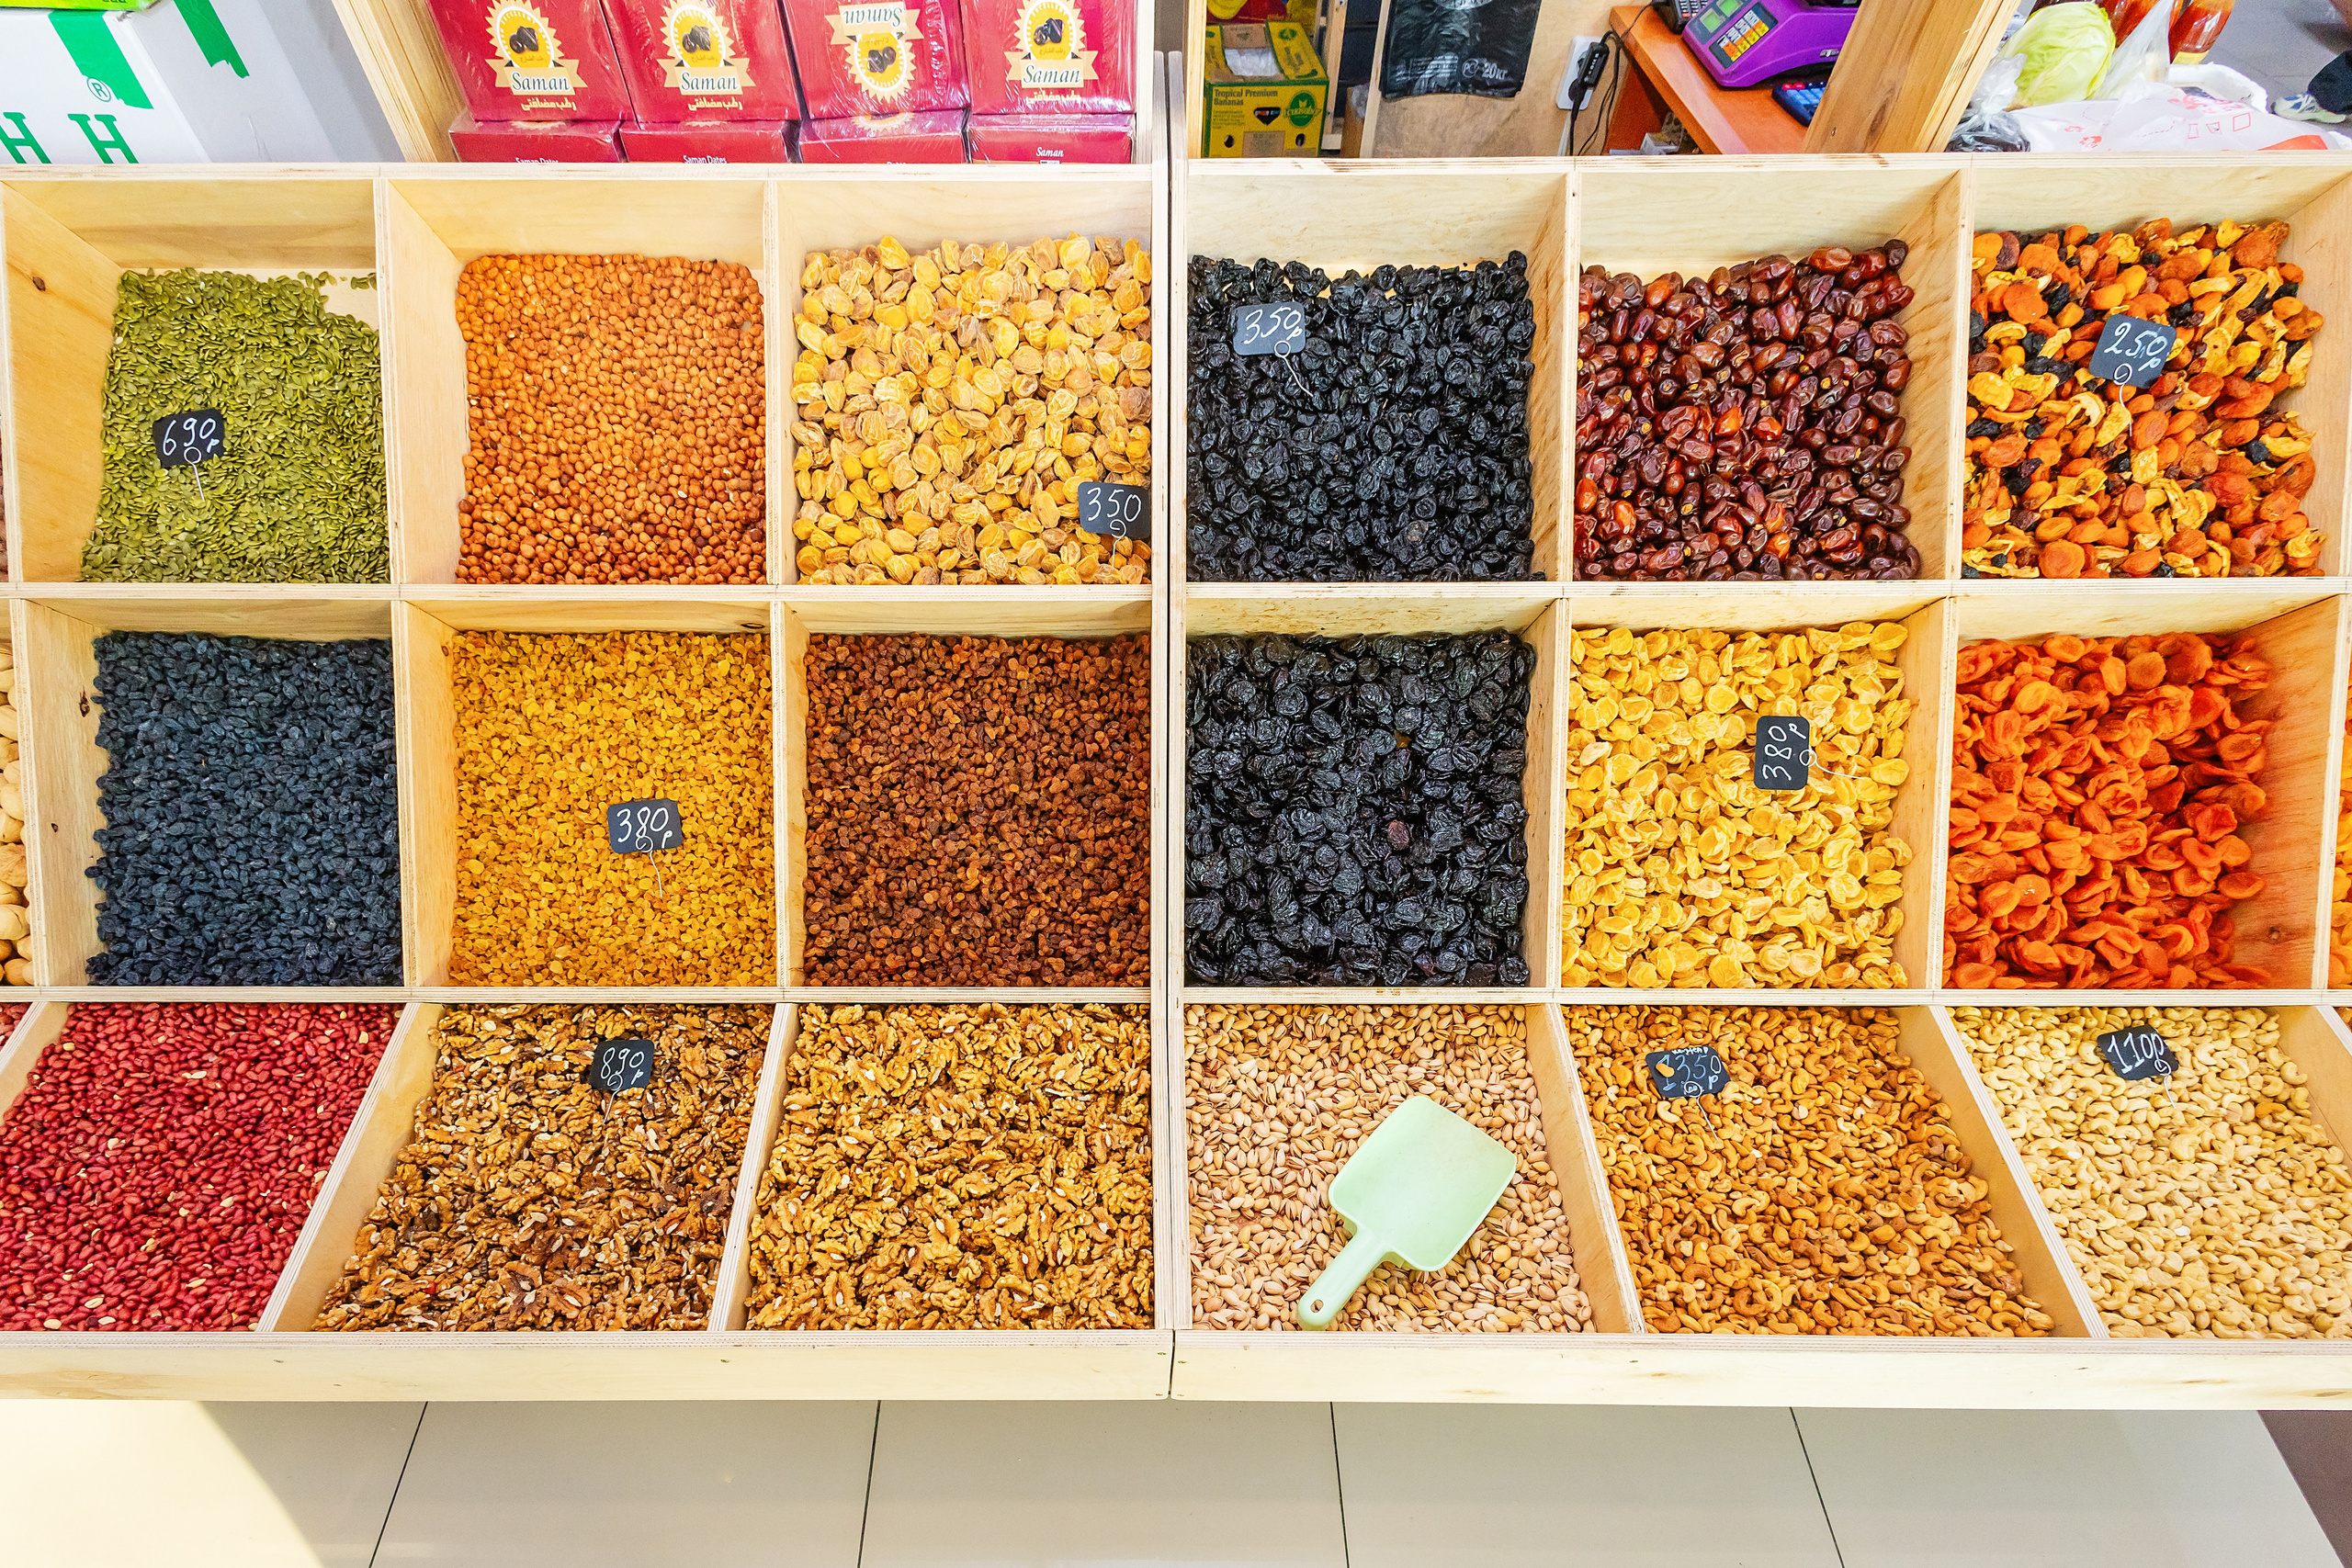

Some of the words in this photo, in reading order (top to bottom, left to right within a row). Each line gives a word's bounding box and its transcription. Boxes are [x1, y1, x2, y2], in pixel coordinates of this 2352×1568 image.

[842, 6, 902, 28] Saman
[511, 72, 571, 91] Saman
[681, 71, 739, 91] Saman
[1023, 64, 1081, 84] Saman
[1214, 88, 1243, 98] Tropical
[1245, 88, 1278, 97] Premium
[1035, 146, 1064, 157] Saman
[1087, 486, 1142, 523] 350
